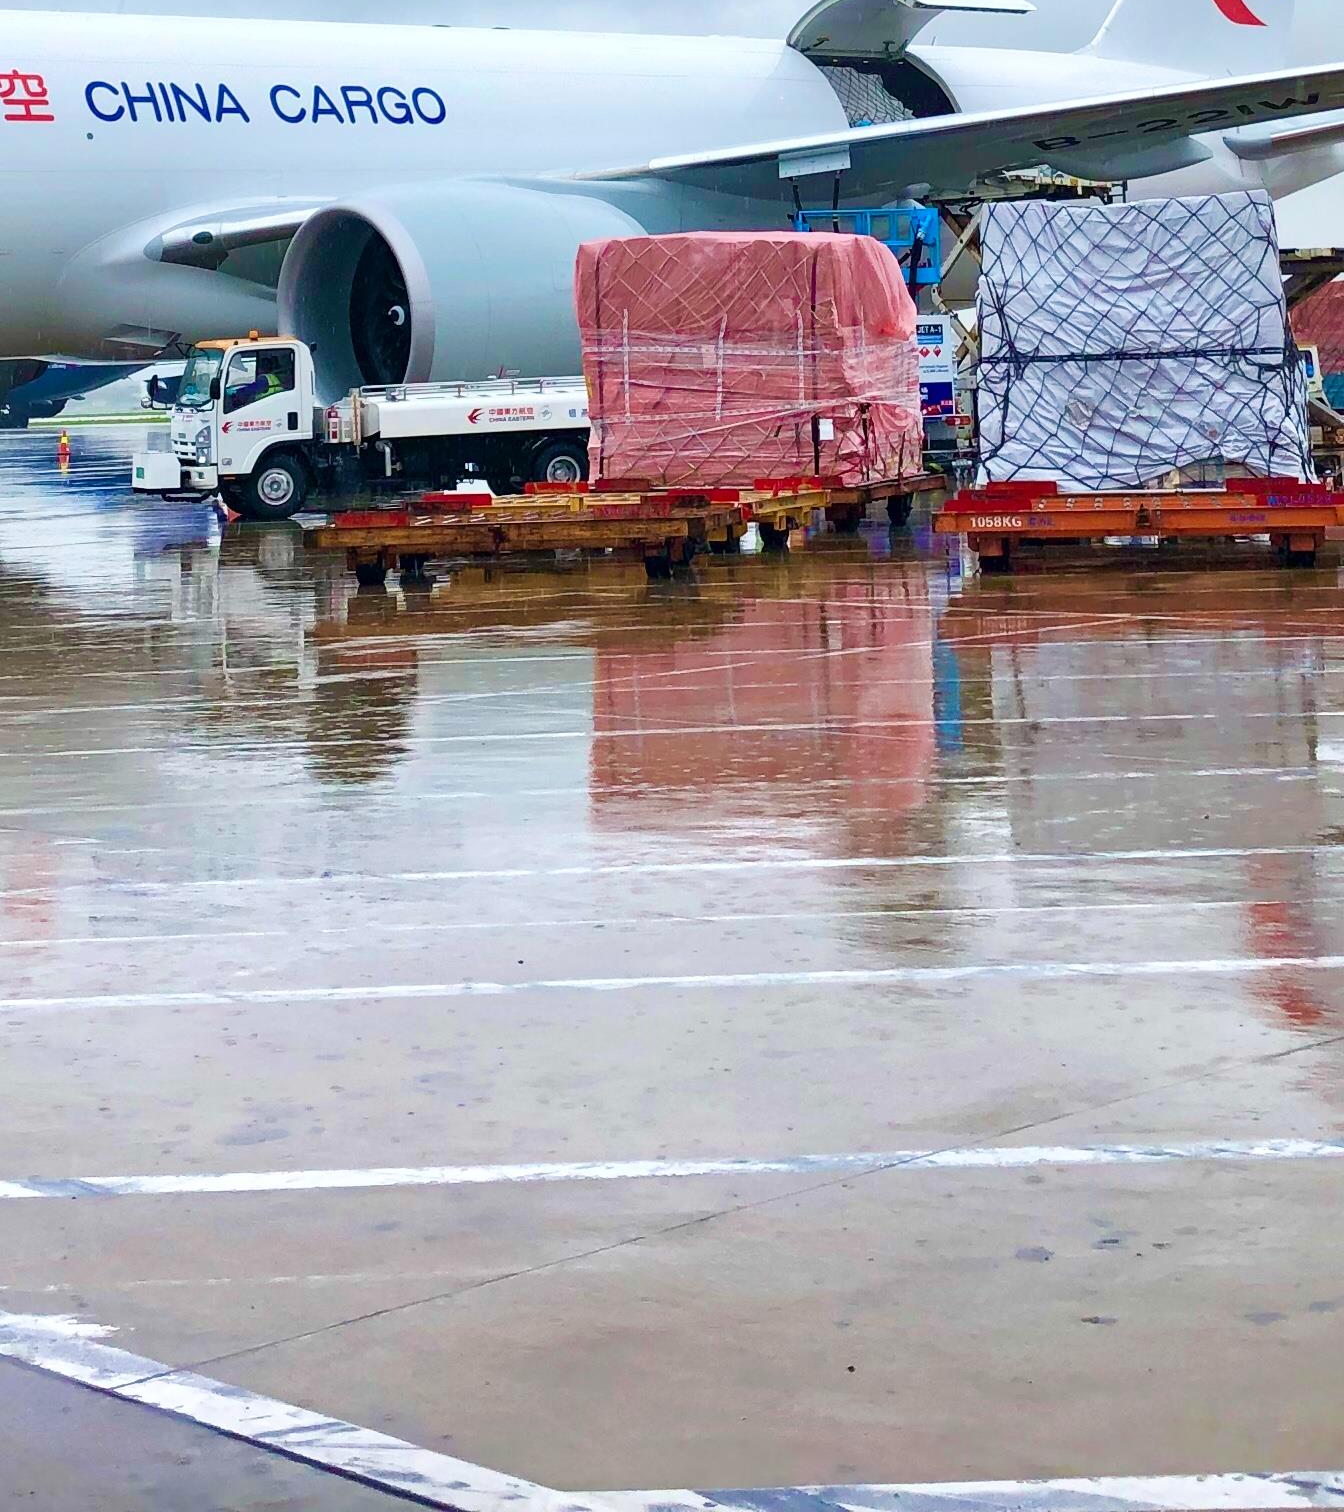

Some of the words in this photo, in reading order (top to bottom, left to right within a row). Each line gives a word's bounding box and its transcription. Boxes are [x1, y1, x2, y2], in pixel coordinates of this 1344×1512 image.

[84, 80, 250, 124] CHINA
[269, 84, 447, 125] CARGO
[917, 325, 929, 334] JET
[969, 515, 1022, 528] 1058KG
